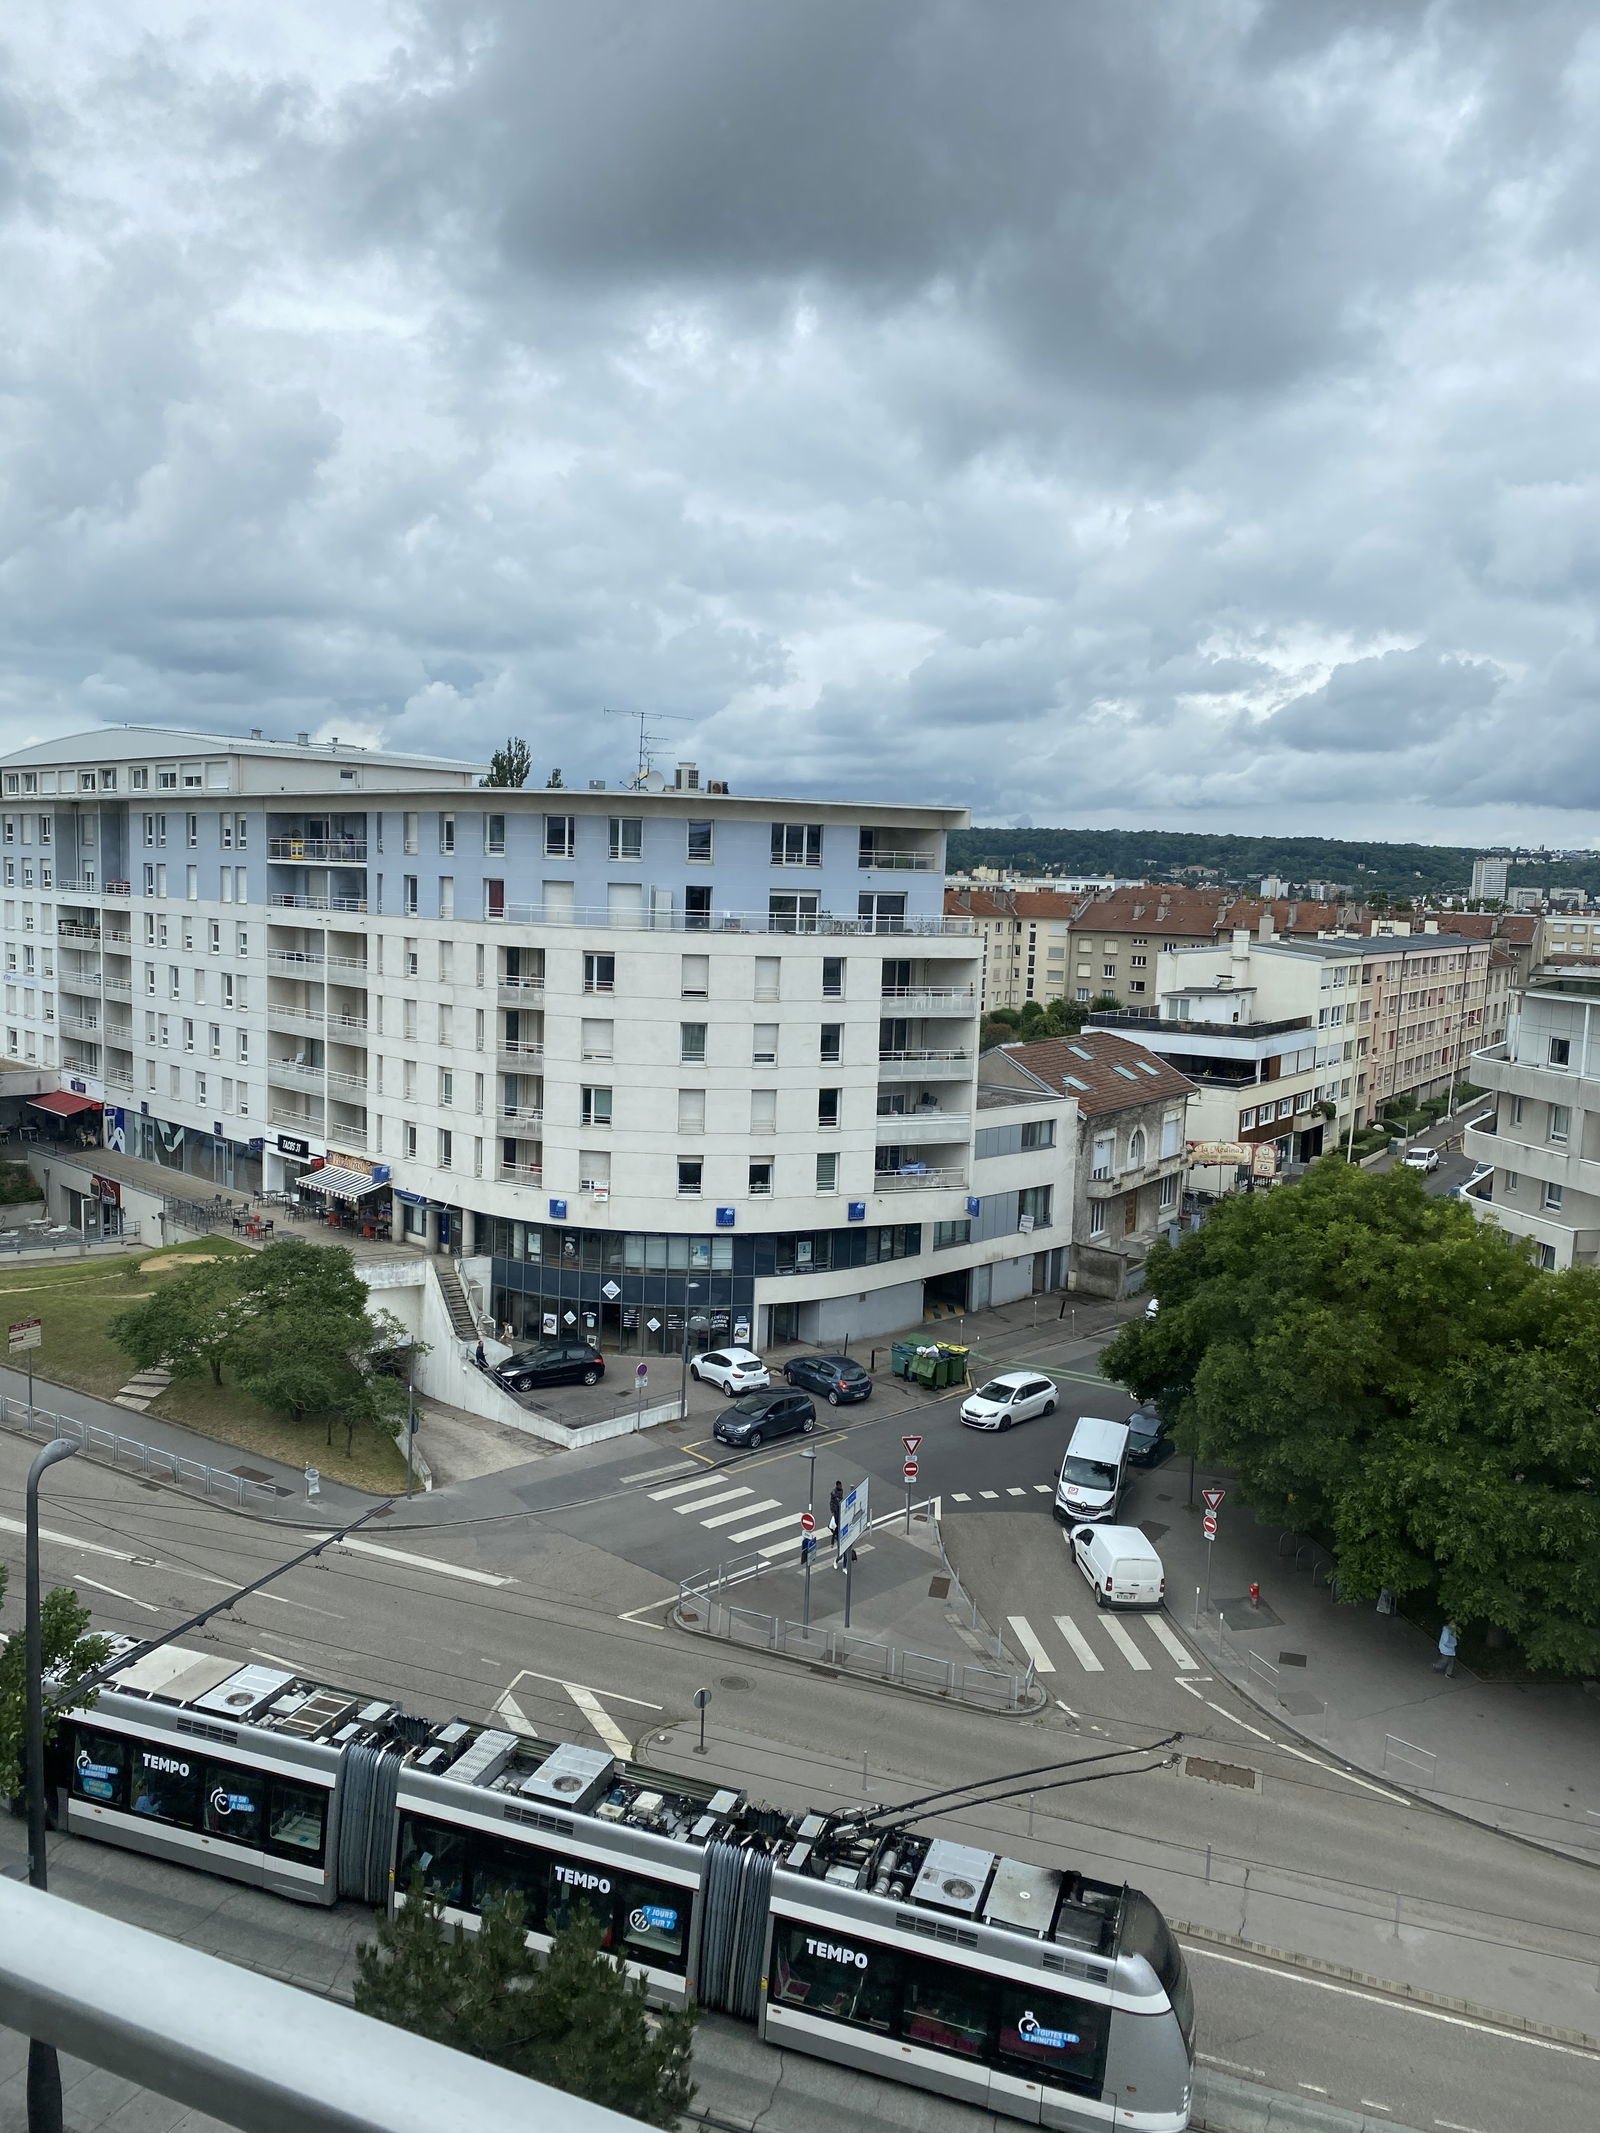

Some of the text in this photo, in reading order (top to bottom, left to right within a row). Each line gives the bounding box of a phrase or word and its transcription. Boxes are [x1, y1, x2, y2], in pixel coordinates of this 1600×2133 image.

[282, 1139, 296, 1151] TACOS
[142, 1752, 190, 1777] TEMPO
[554, 1865, 611, 1894] TEMPO
[645, 1907, 674, 1918] 7 JOURS
[651, 1918, 671, 1928] SUR 7
[805, 1938, 868, 1969] TEMPO
[1030, 2034, 1061, 2047] MINUTES
[1036, 2029, 1062, 2040] TOUTES
